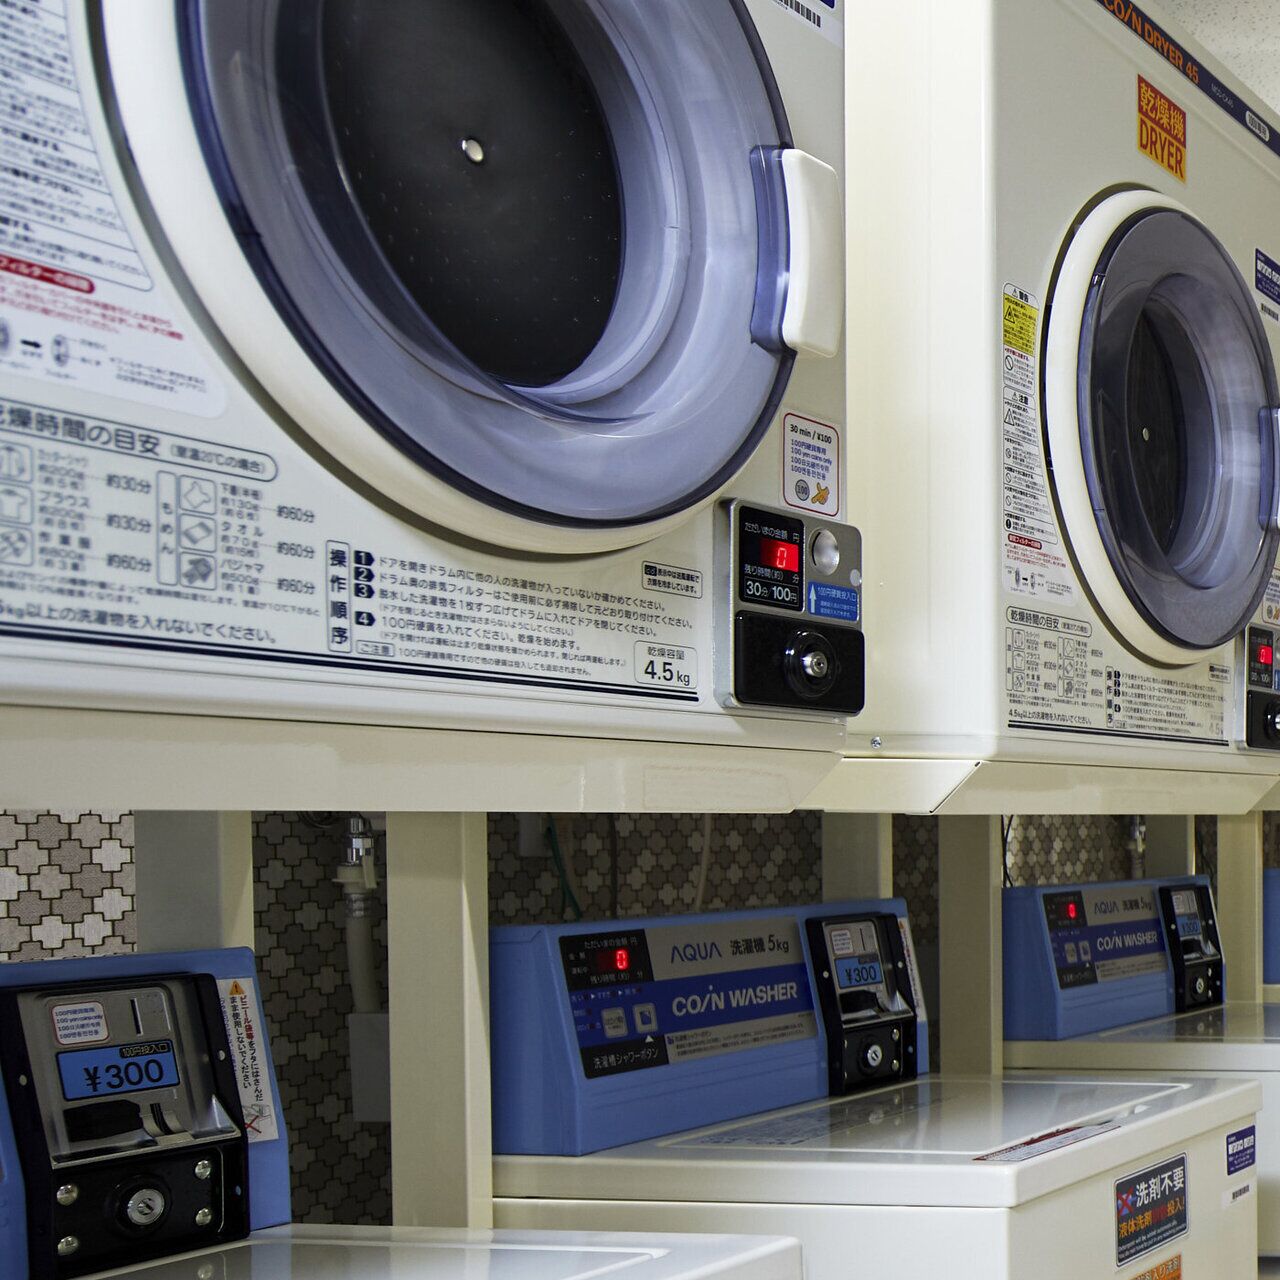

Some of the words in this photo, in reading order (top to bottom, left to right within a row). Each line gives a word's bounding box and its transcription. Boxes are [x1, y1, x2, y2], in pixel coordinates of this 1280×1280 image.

[1144, 22, 1184, 70] DRYER
[1185, 62, 1199, 84] 45
[1140, 82, 1184, 142] 乾燥機
[1139, 117, 1184, 178] DRYER
[0, 403, 160, 456] 燥時間の目安
[790, 423, 799, 434] 30
[799, 426, 812, 439] min
[817, 431, 833, 445] ¥100
[792, 532, 800, 543] 円
[776, 547, 787, 569] 0
[792, 575, 800, 584] 分
[330, 549, 348, 645] 操作順序
[647, 646, 685, 660] 乾燥容量
[644, 659, 674, 682] 4.5
[677, 669, 691, 686] kg
[1094, 900, 1119, 915] AQUA
[671, 941, 723, 964] AQUA
[730, 938, 766, 956] 洗濯機
[767, 935, 790, 955] 5kg
[1097, 929, 1122, 951] COIN
[1124, 931, 1158, 948] WASHER
[845, 965, 877, 985] ¥300
[671, 985, 725, 1018] COIN
[729, 982, 798, 1009] WASHER
[83, 1058, 164, 1092] ¥300
[1136, 1166, 1184, 1208] 洗剤不要
